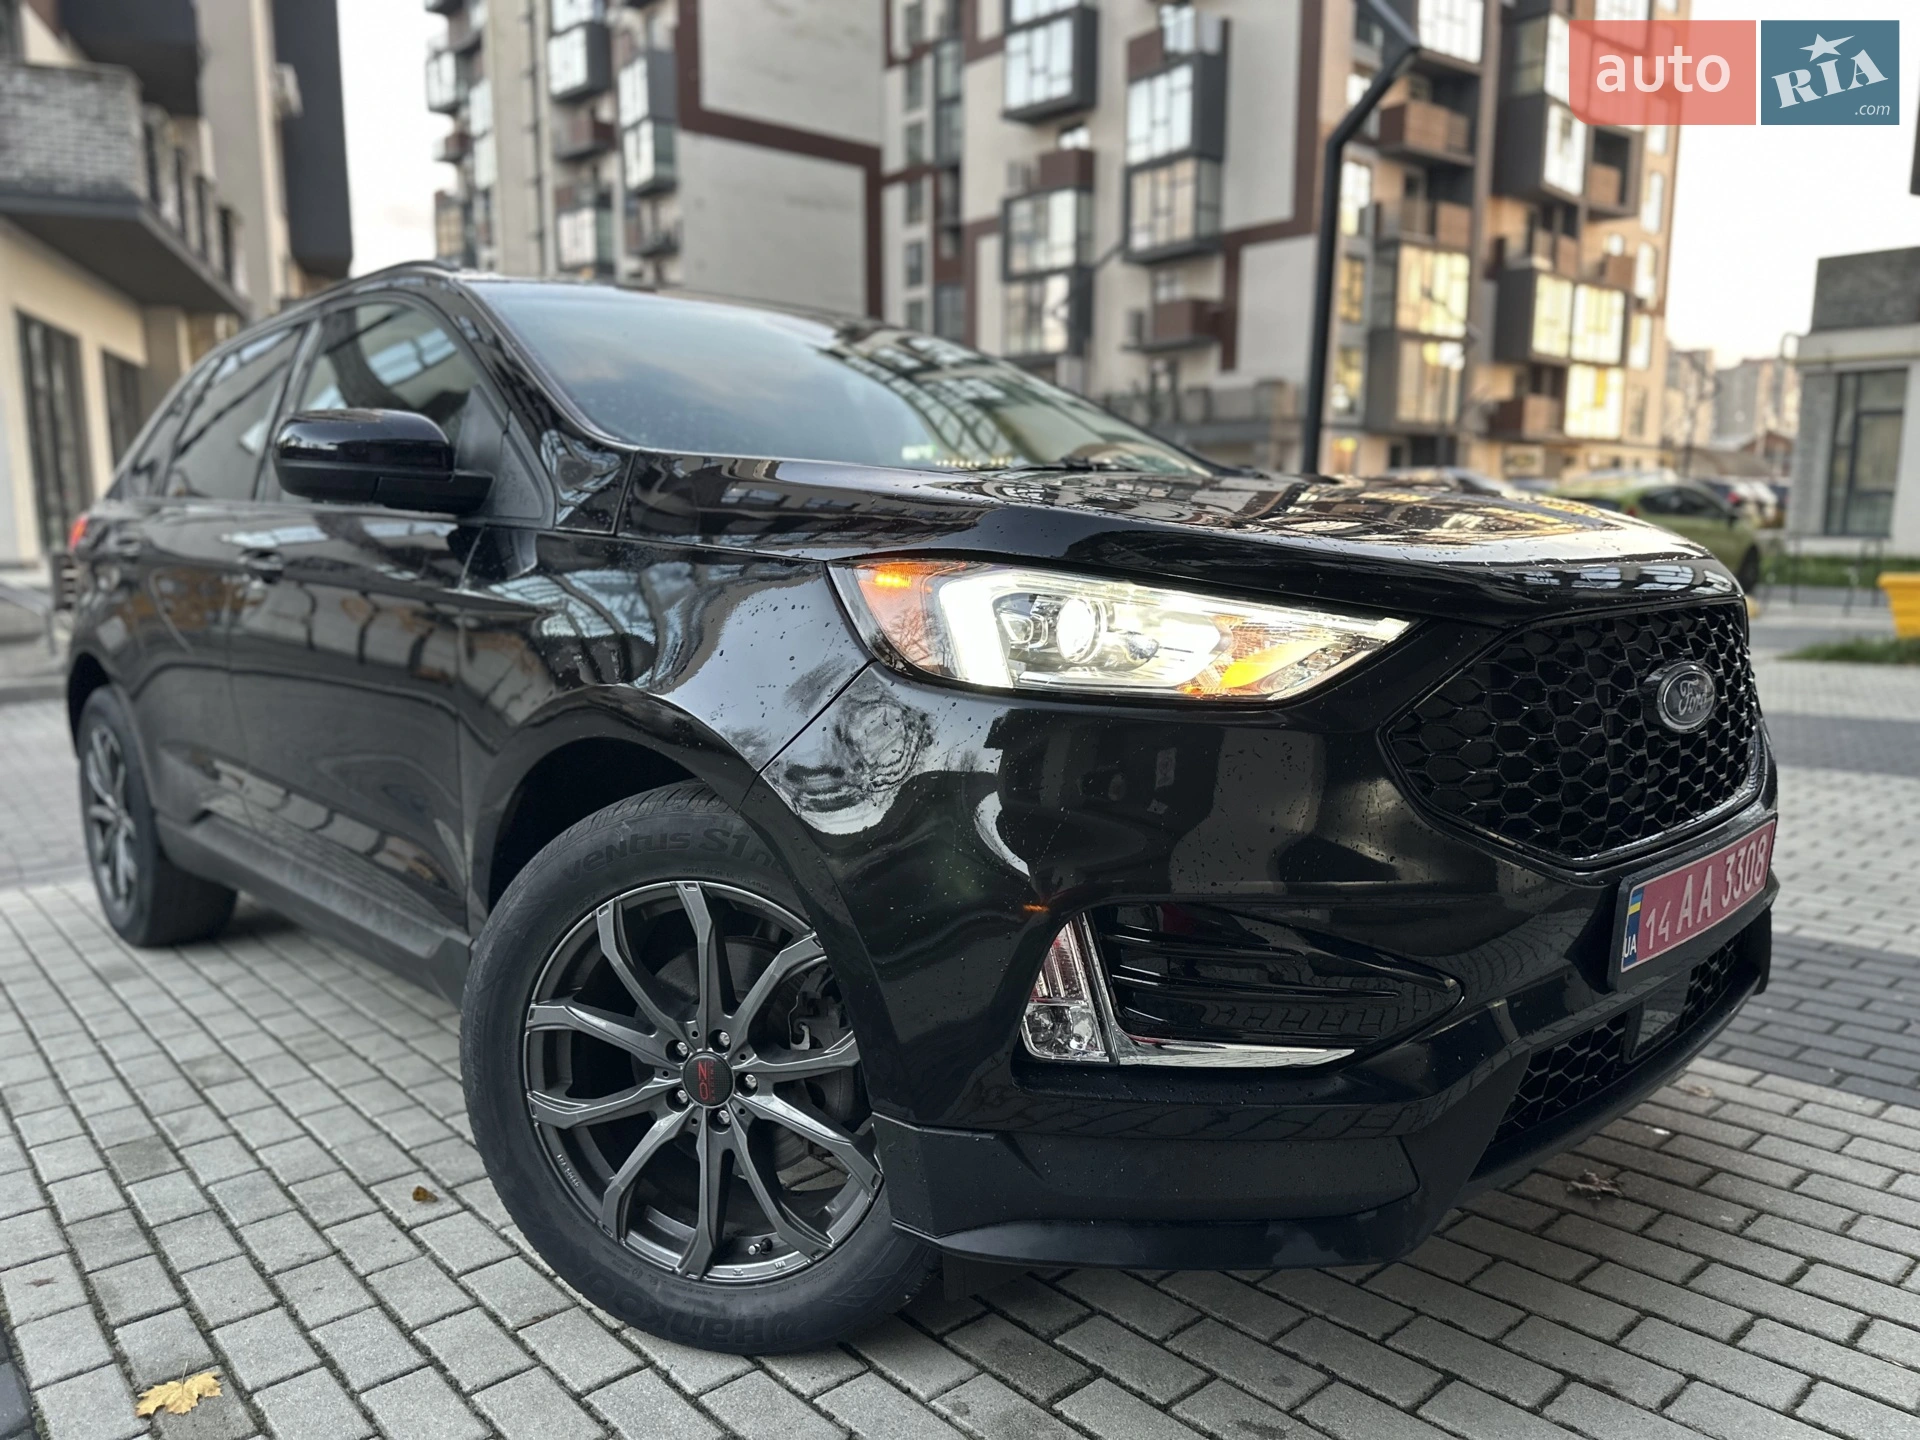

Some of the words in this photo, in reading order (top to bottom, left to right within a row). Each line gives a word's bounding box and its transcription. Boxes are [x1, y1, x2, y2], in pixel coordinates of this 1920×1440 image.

[1678, 678, 1708, 716] Ford
[1646, 901, 1671, 949] 14
[1676, 865, 1713, 934] AA
[1721, 834, 1768, 908] 3308
[1623, 936, 1637, 958] UA
